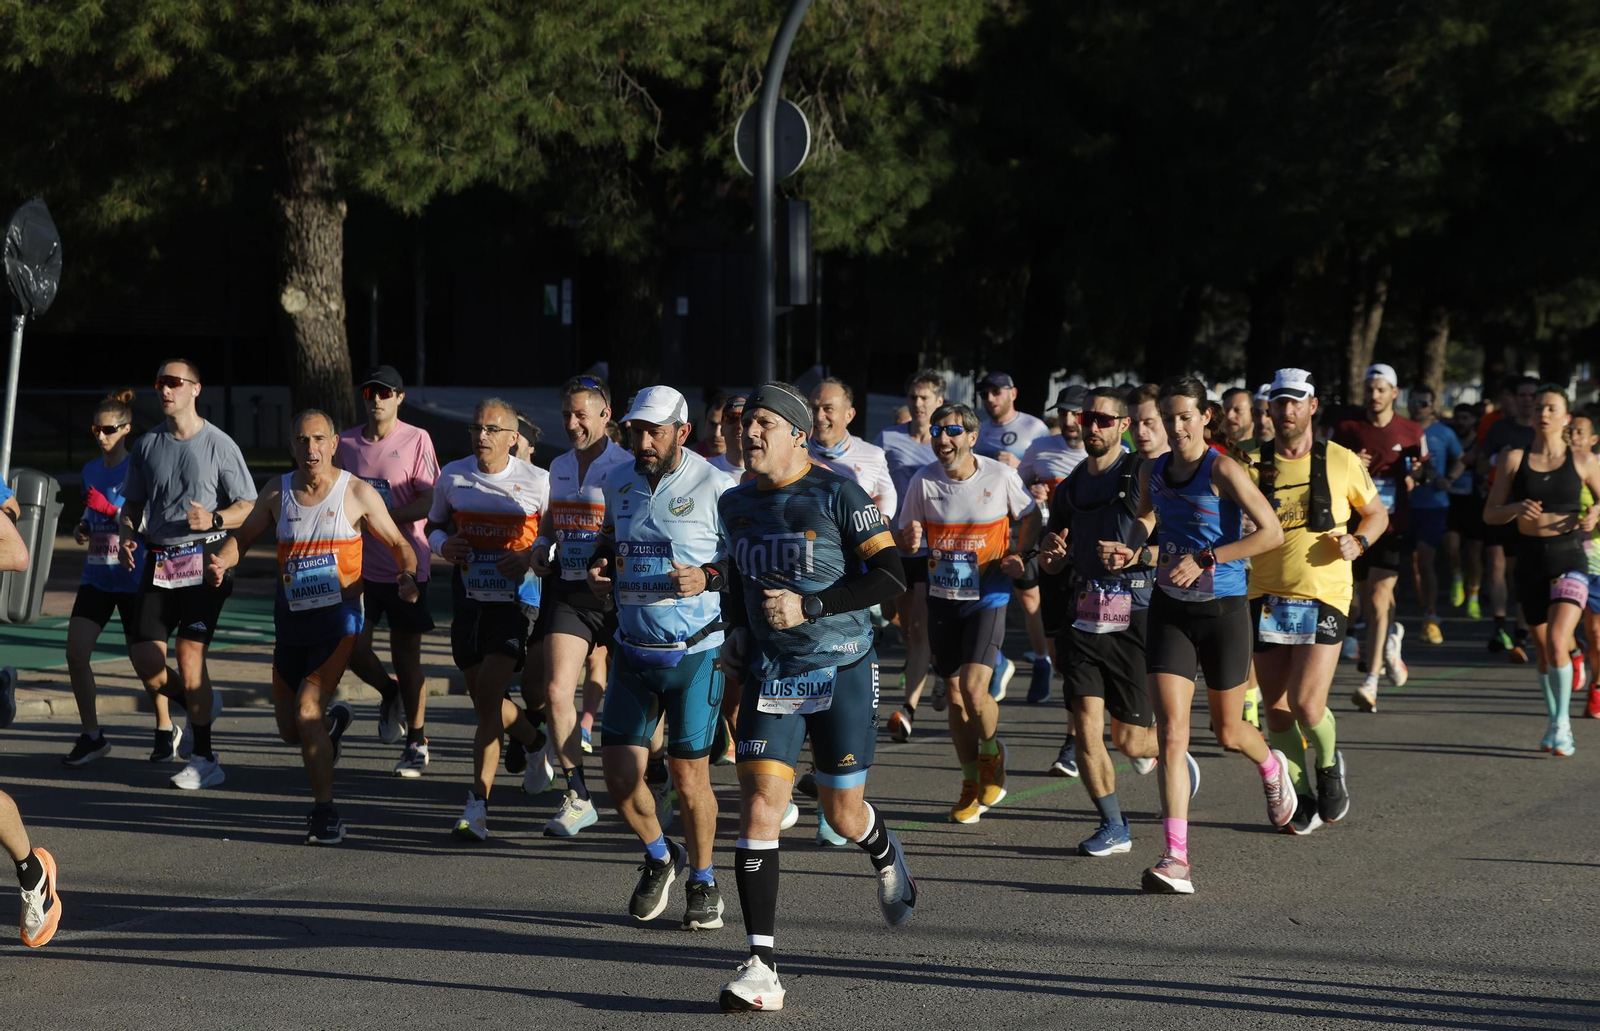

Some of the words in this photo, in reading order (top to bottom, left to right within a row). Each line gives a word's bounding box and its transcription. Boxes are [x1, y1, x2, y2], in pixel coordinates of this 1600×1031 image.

[1277, 510, 1306, 522] WORLD
[632, 545, 668, 555] ZURICH
[297, 557, 329, 570] ZURICH
[633, 564, 652, 573] 6357
[301, 575, 318, 583] 6170
[467, 578, 507, 589] HILARIO
[933, 575, 973, 588] MANOLO
[291, 582, 334, 599] MANUEL
[618, 581, 641, 591] CARLOS
[1276, 621, 1303, 634] OLAF
[762, 682, 793, 697] LUIS
[797, 681, 833, 697] SILVA
